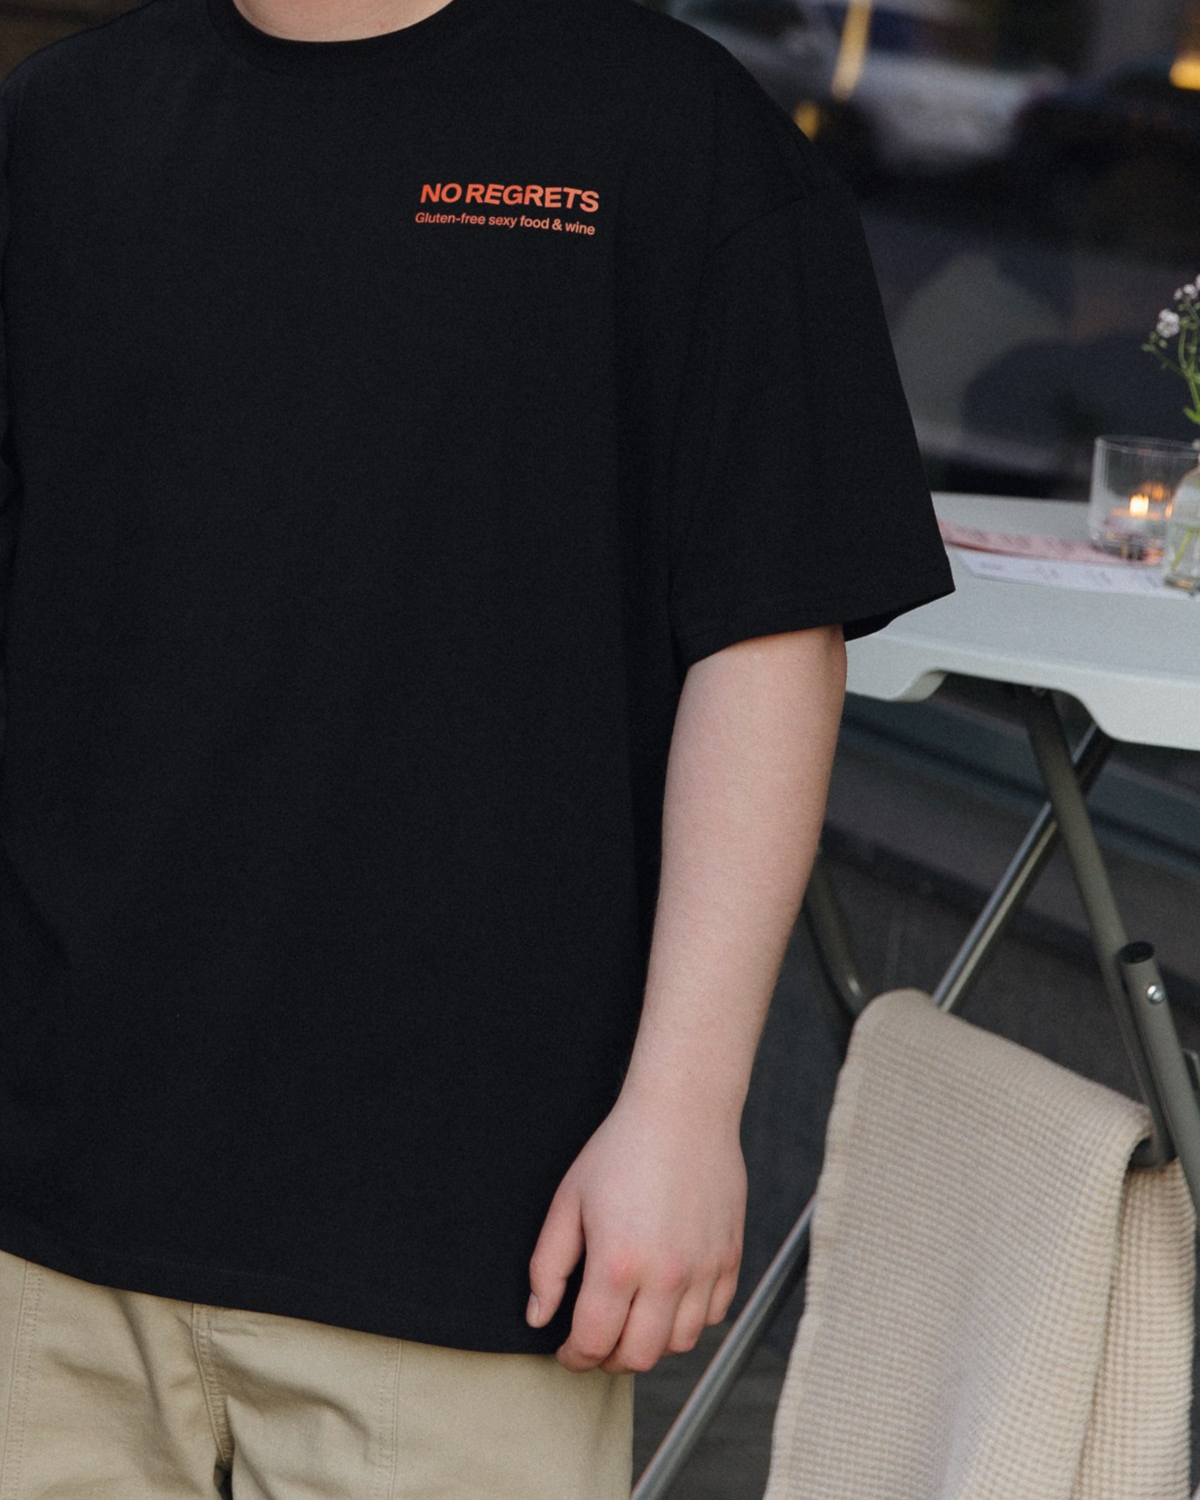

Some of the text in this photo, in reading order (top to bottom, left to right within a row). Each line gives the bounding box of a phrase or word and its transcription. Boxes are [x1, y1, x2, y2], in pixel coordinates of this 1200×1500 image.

[420, 182, 600, 213] NO REGRETS
[414, 211, 596, 236] Gluten-free sexy food & wine
